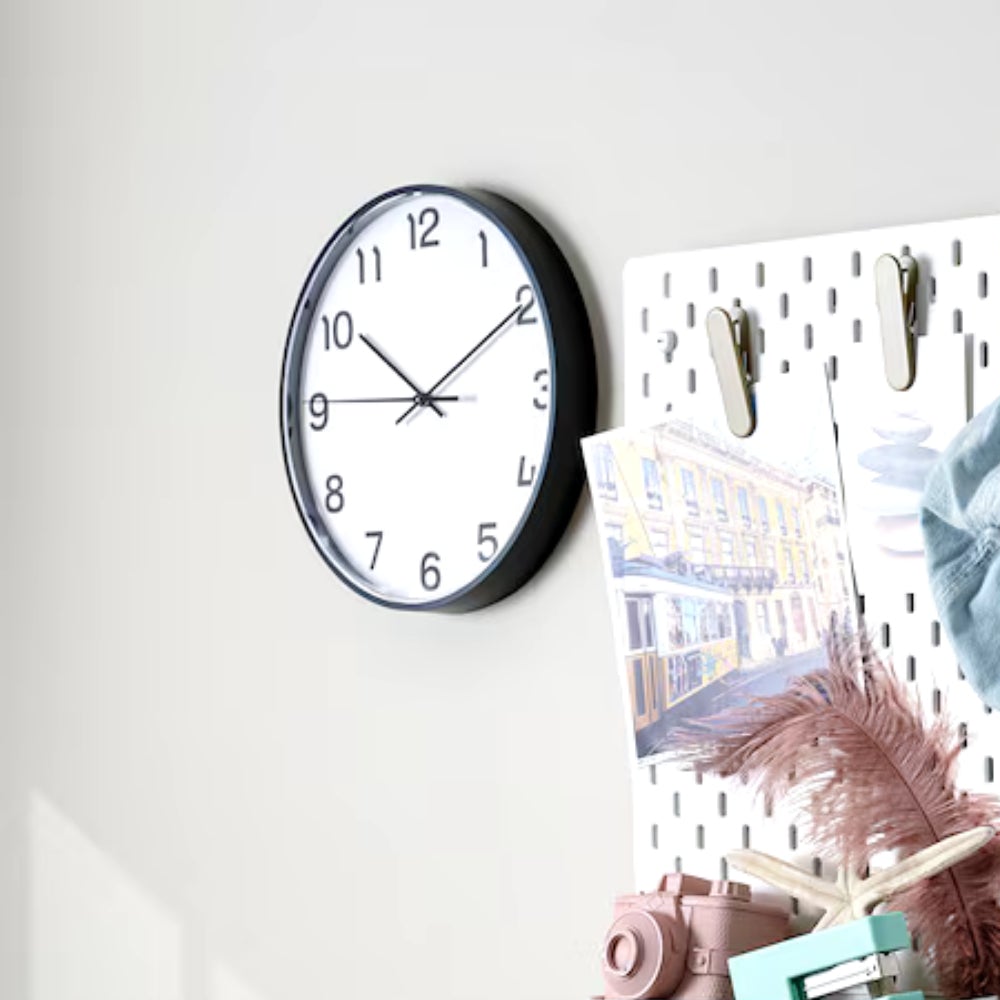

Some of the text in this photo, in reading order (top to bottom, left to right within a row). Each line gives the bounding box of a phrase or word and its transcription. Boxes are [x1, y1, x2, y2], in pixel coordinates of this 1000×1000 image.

[407, 208, 440, 250] 12
[479, 230, 489, 268] 1
[355, 245, 382, 284] 11
[515, 284, 538, 325] 2
[321, 310, 354, 351] 10
[309, 392, 330, 431] 9
[325, 474, 345, 513] 8
[365, 531, 384, 571] 7
[477, 522, 498, 563] 5
[420, 552, 441, 592] 6
